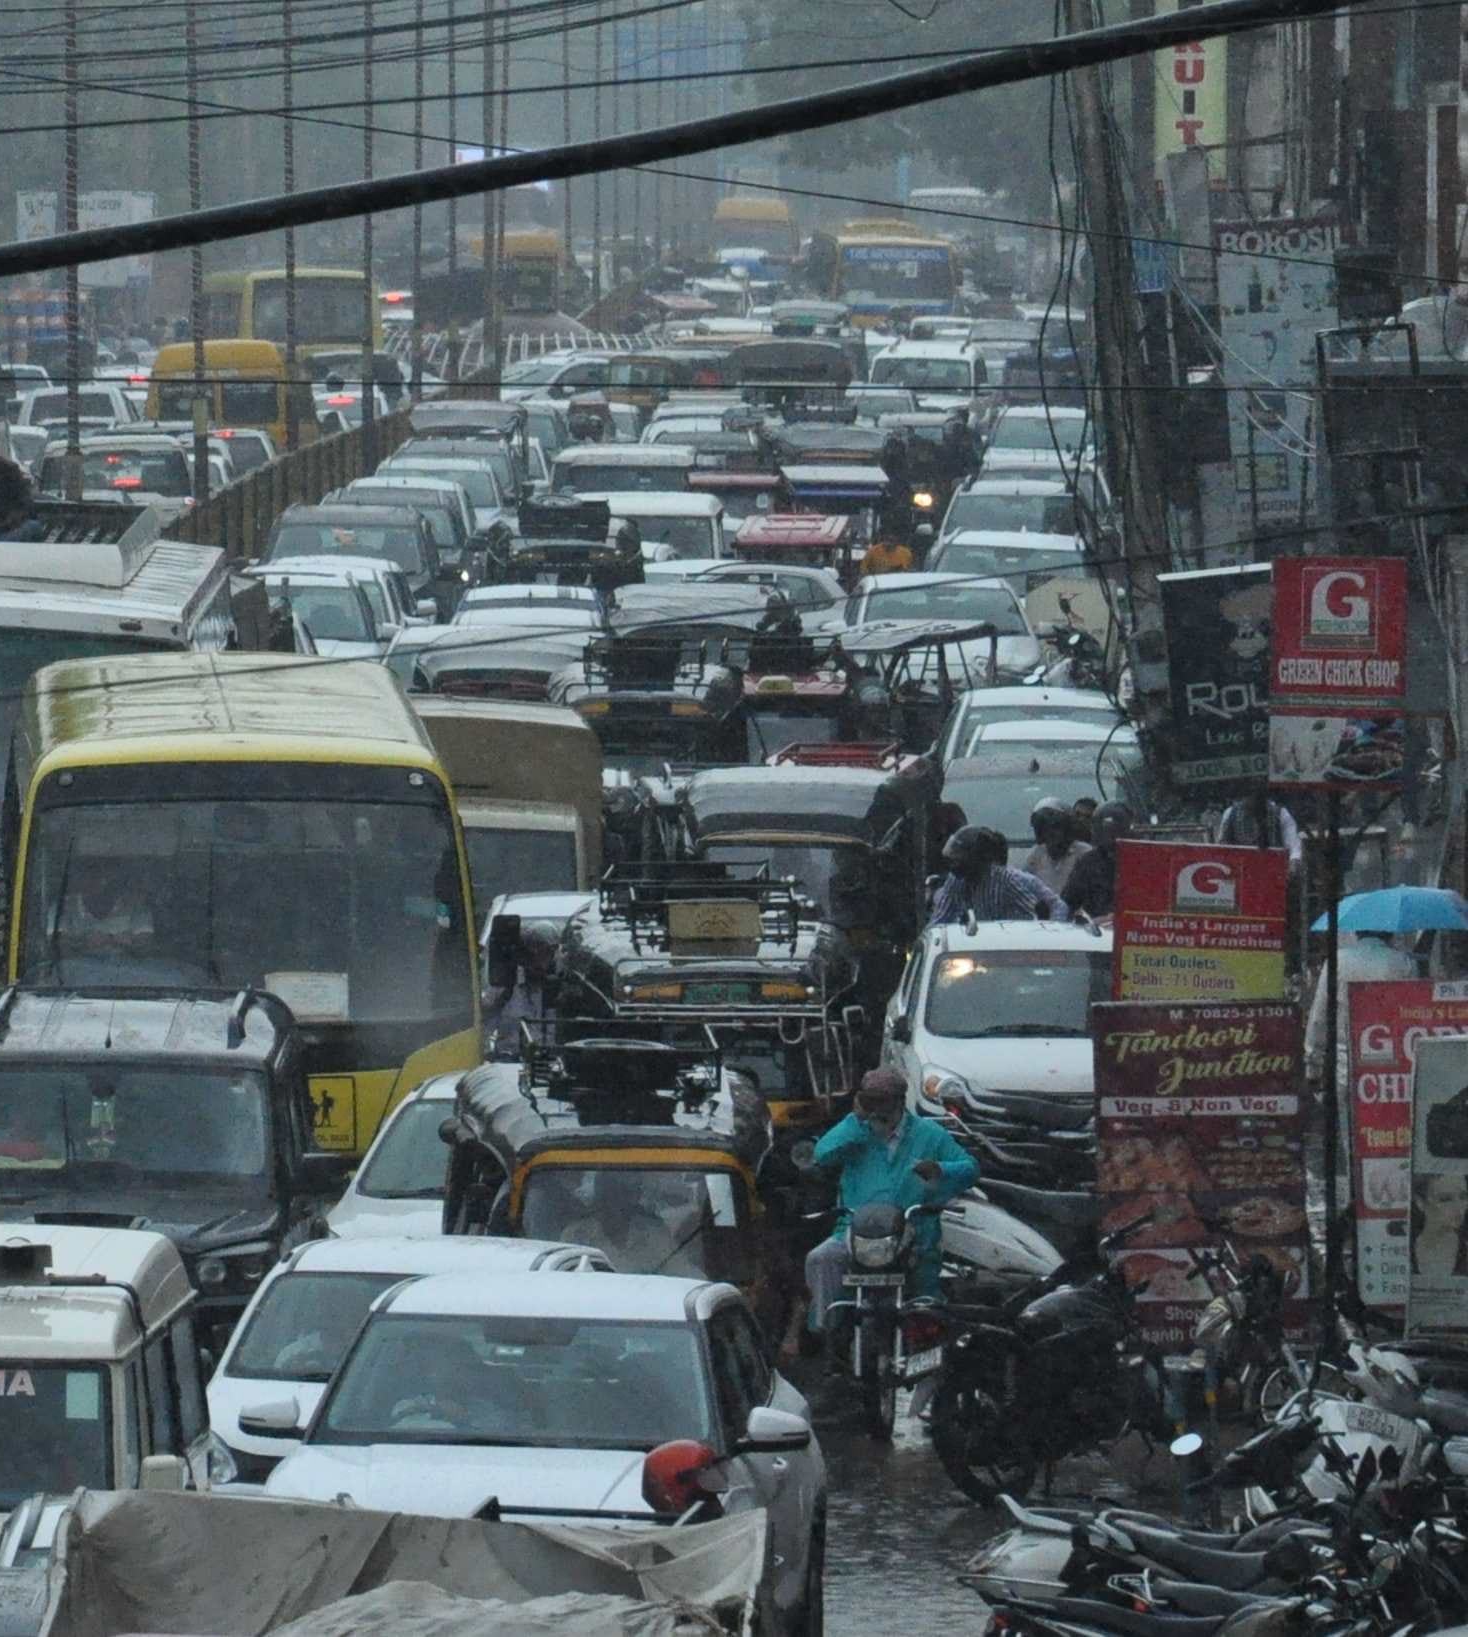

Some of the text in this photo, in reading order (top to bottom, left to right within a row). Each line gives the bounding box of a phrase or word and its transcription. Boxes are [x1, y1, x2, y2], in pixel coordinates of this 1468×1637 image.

[1278, 658, 1400, 688] GREEN CHICK CHOP
[1186, 681, 1269, 719] ROL
[1142, 916, 1266, 935] India's Largest
[1126, 931, 1282, 949] Non-Veg Franchise
[1133, 953, 1166, 968] Total
[1192, 975, 1236, 990] Outlets
[1105, 1022, 1259, 1063] Tandoori
[1155, 1050, 1294, 1095] Junction
[1357, 1073, 1413, 1104] CHI
[1191, 1099, 1232, 1112] Non
